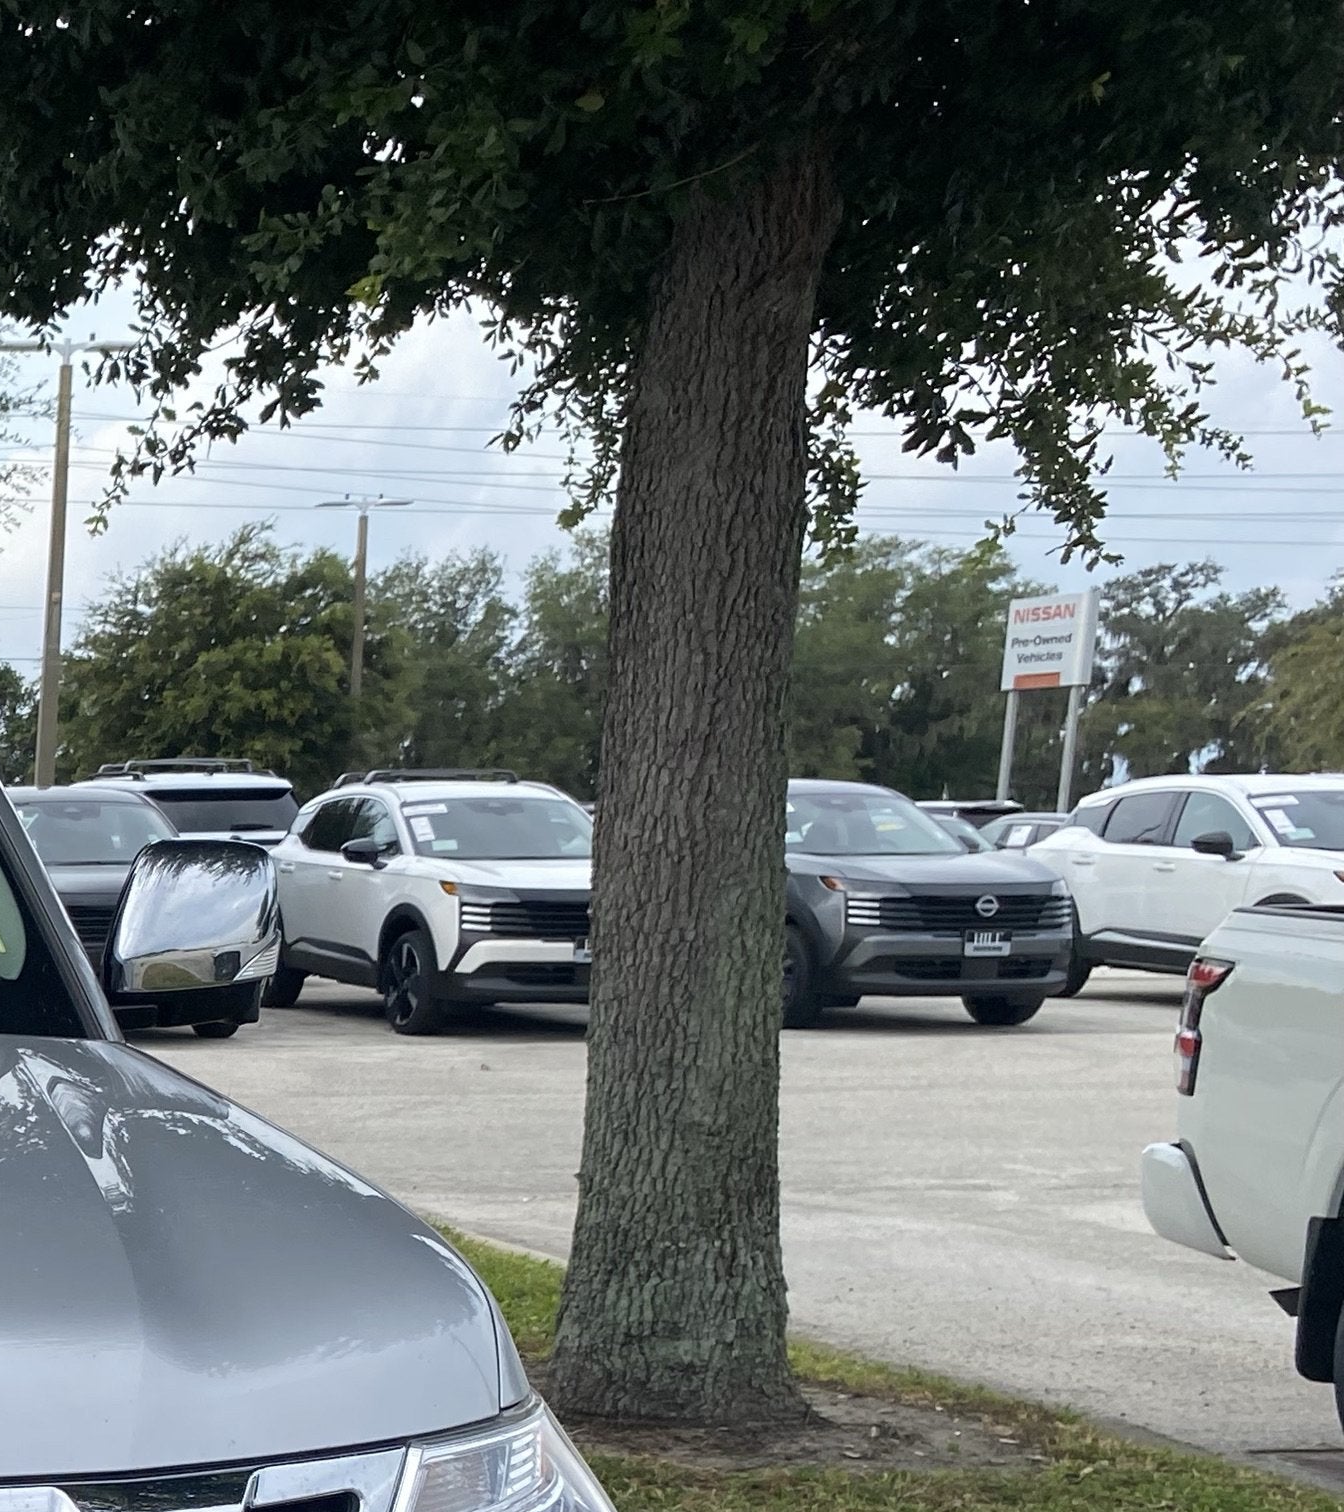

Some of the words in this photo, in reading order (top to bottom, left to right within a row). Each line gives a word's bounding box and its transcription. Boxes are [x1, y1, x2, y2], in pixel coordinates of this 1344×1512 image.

[1014, 603, 1076, 624] NISSAN
[1011, 633, 1072, 649] Pre-Owned
[1017, 652, 1063, 664] Vehicles
